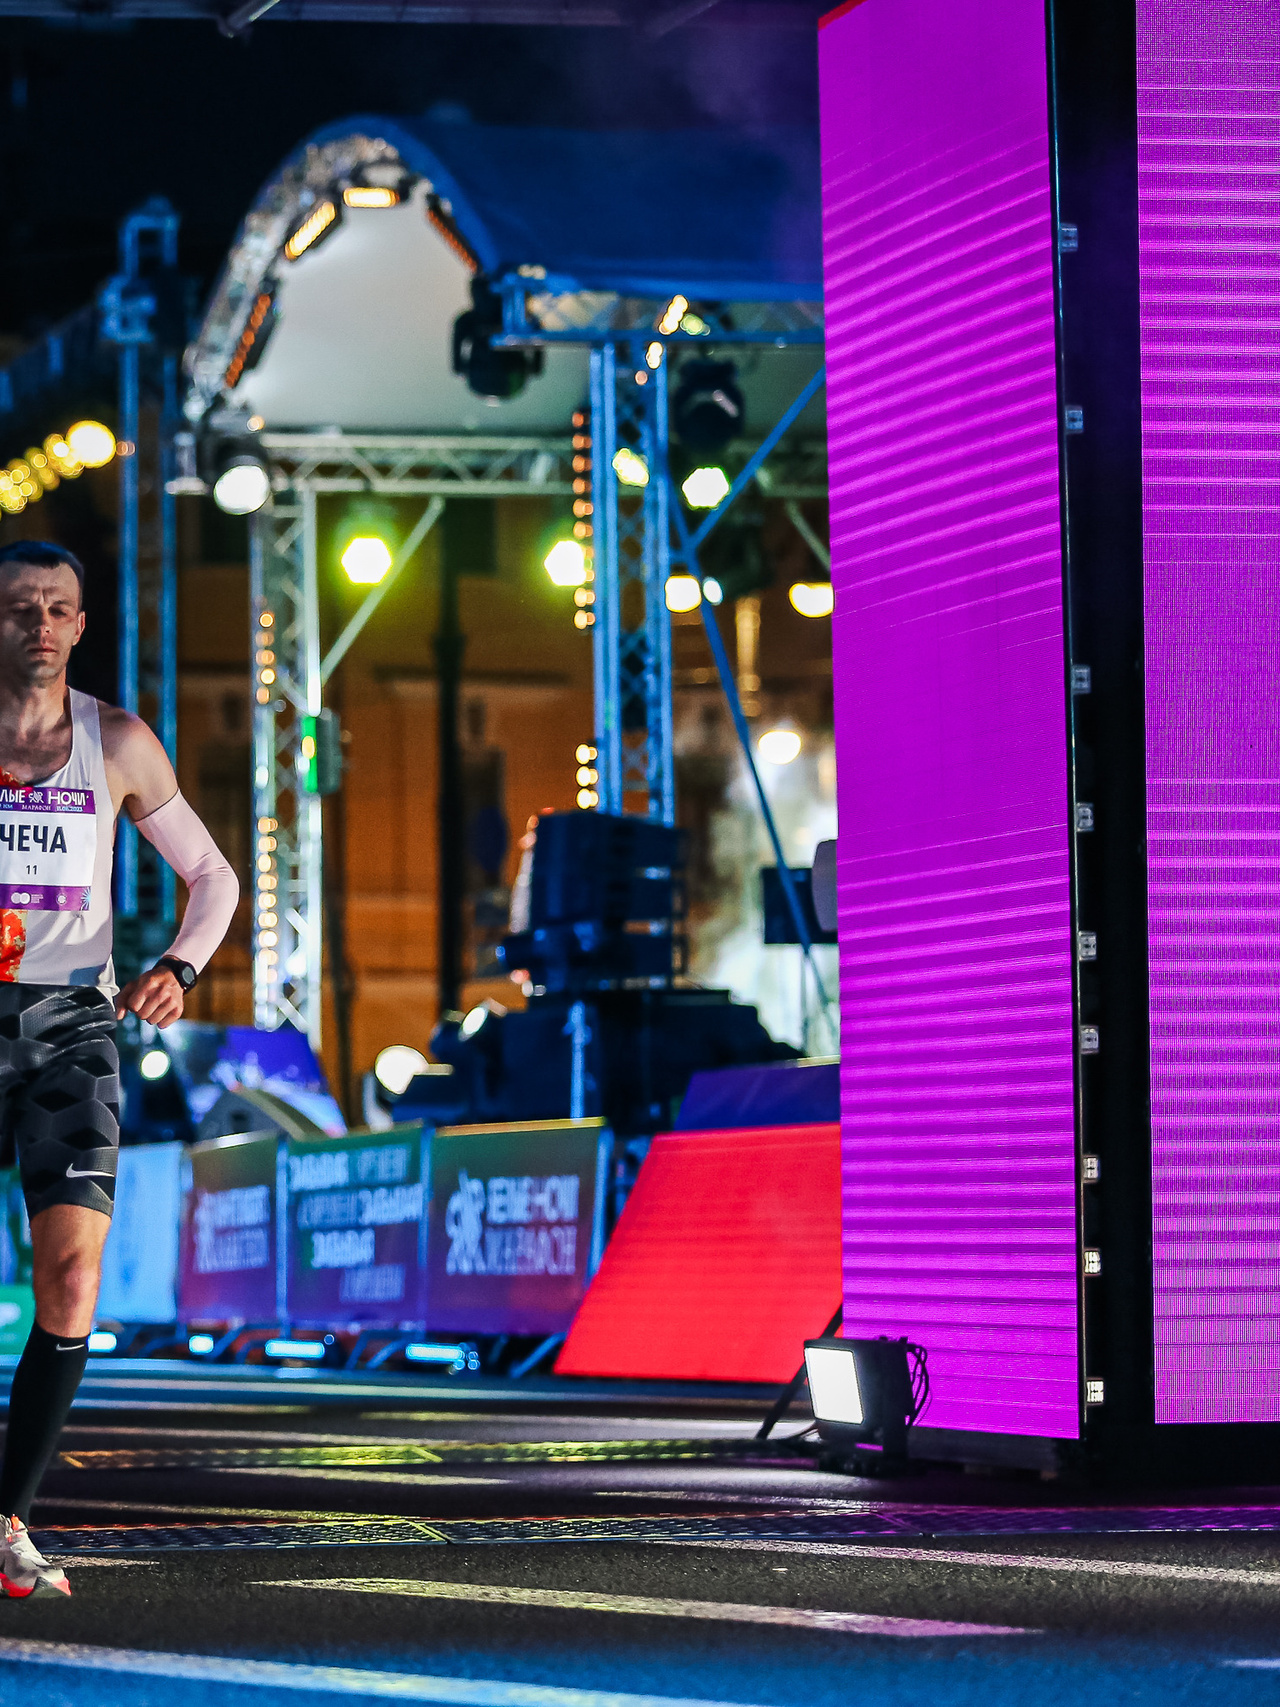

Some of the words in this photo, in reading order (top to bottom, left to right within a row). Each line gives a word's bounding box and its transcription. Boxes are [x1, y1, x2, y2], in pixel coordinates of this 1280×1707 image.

[48, 790, 86, 806] НОЧИ
[0, 823, 67, 853] ЧЕЧА
[25, 865, 38, 875] 11
